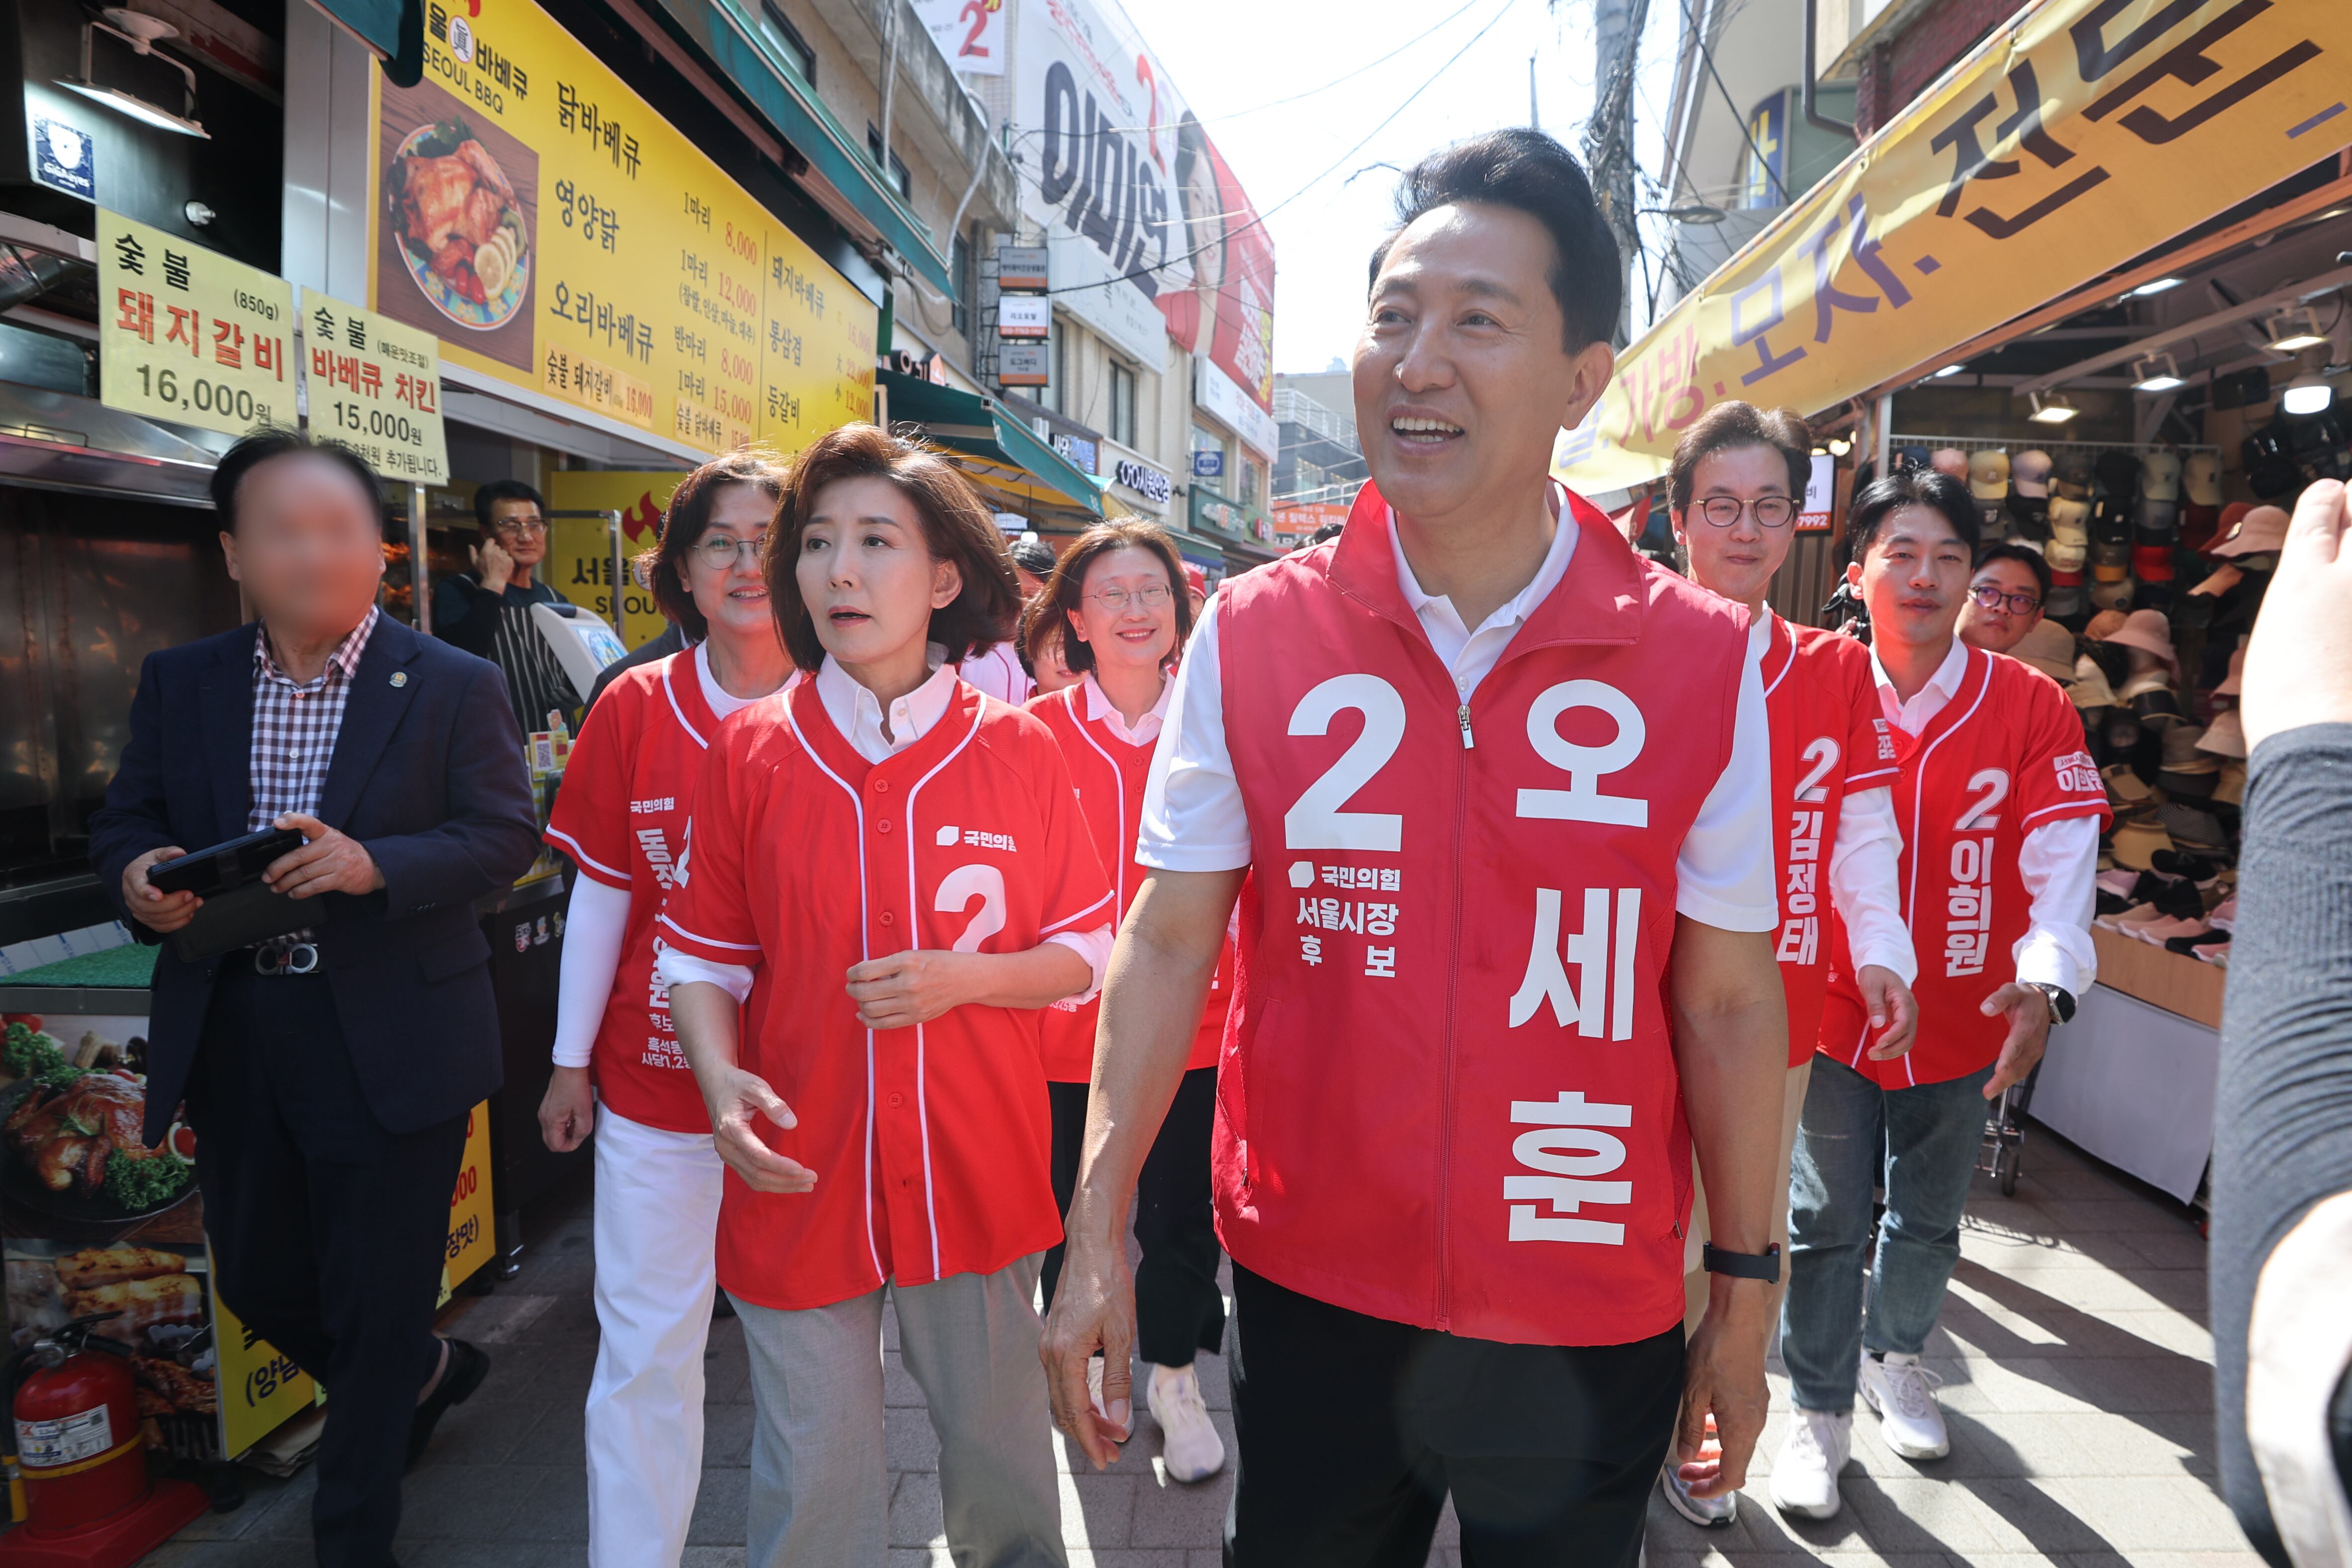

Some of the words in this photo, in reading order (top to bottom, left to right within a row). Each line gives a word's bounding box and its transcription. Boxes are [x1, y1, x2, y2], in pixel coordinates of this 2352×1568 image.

[958, 1, 989, 57] 2
[423, 41, 471, 94] SEOUL
[475, 79, 503, 115] BBQ
[476, 37, 527, 100] 바베큐
[557, 81, 642, 180] 닭바베큐
[555, 180, 620, 254] 영양닭
[684, 192, 710, 233] 1마리
[681, 249, 708, 288] 1마리
[772, 255, 825, 321] 돼지바베큐
[233, 288, 279, 321] (850g)
[550, 282, 655, 365] 오리바베큐
[116, 287, 283, 382] 돼지갈비
[377, 340, 429, 370] (매운맛조절)
[674, 326, 705, 366] 반마리
[769, 319, 802, 367] 통삼겹
[136, 363, 272, 426] 16,000원
[311, 347, 383, 399] 바베큐
[395, 373, 436, 414] 치킨
[573, 362, 612, 406] 돼지갈비
[679, 369, 705, 403] 1마리
[333, 400, 422, 447] 15,000원
[767, 385, 800, 430] 등갈비
[386, 450, 442, 478] 추가됩니다.
[571, 557, 630, 586] 서울
[1284, 673, 1407, 852] 2
[1794, 735, 1841, 803] 2
[630, 796, 675, 814] 국민의힘
[1953, 767, 2011, 832] 2
[964, 830, 1017, 853] 국민의힘
[1321, 864, 1401, 891] 국민의힘
[1775, 810, 1825, 966] 김정태
[1296, 897, 1399, 936] 서울시장
[1944, 836, 1995, 979] 이희원
[1503, 678, 1648, 1246] 오세훈
